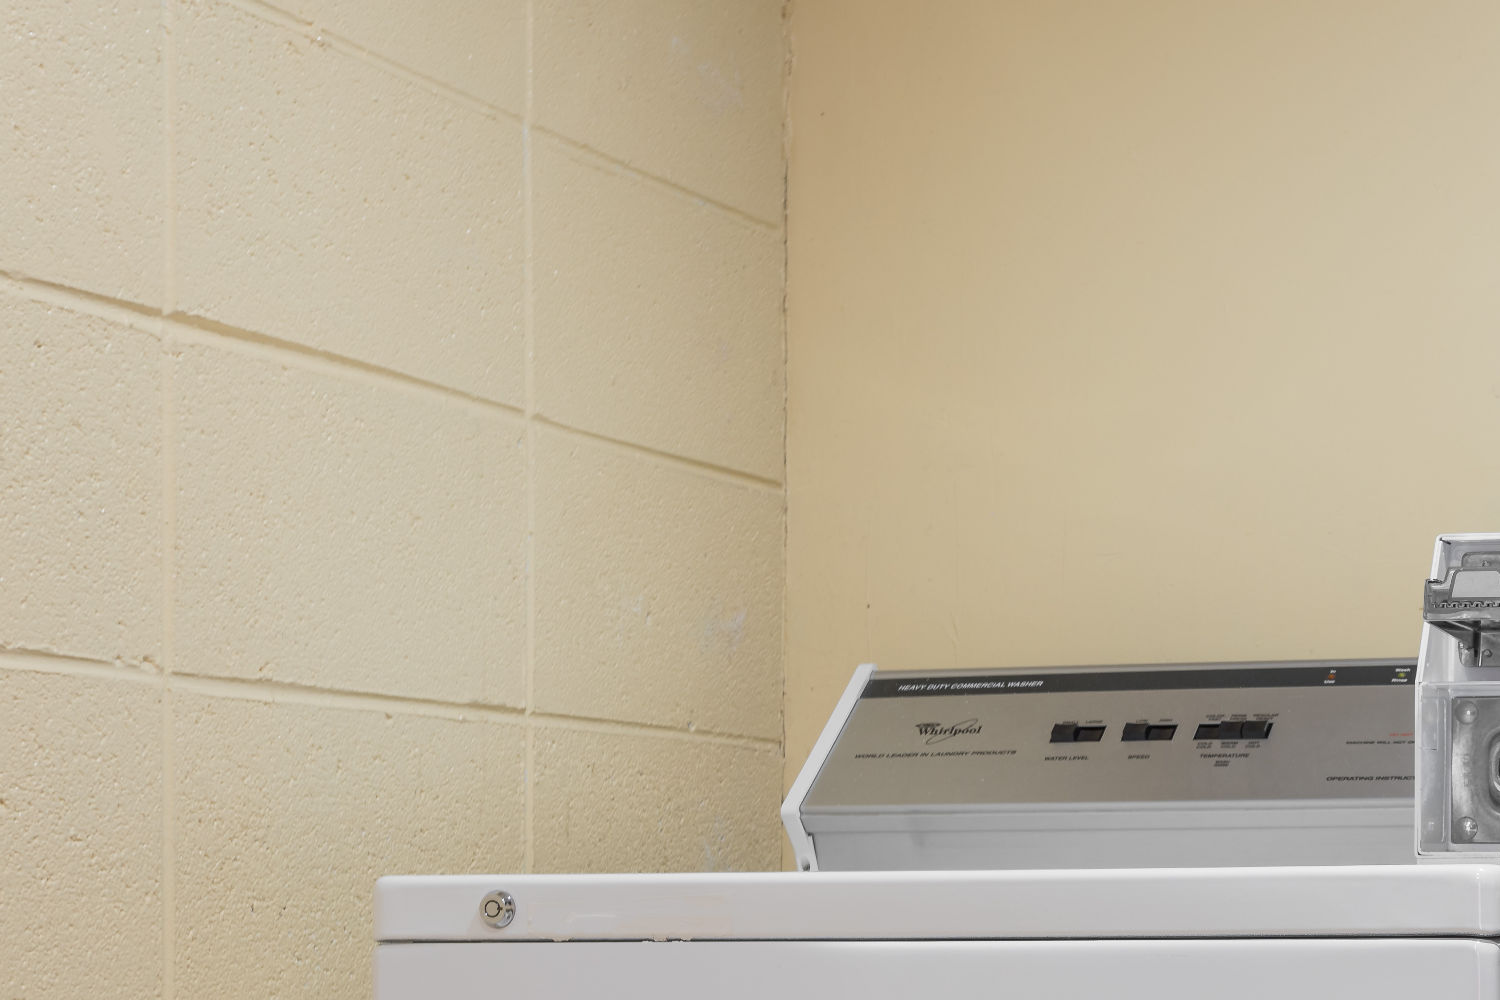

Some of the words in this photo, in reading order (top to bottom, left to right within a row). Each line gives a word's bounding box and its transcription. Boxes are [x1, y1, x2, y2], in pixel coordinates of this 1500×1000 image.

[897, 684, 926, 692] HEAVY
[927, 683, 952, 691] DUTY
[950, 681, 1006, 690] COMMERCIAL
[1006, 680, 1044, 688] WASHER
[970, 749, 1018, 757] PRODUCTS
